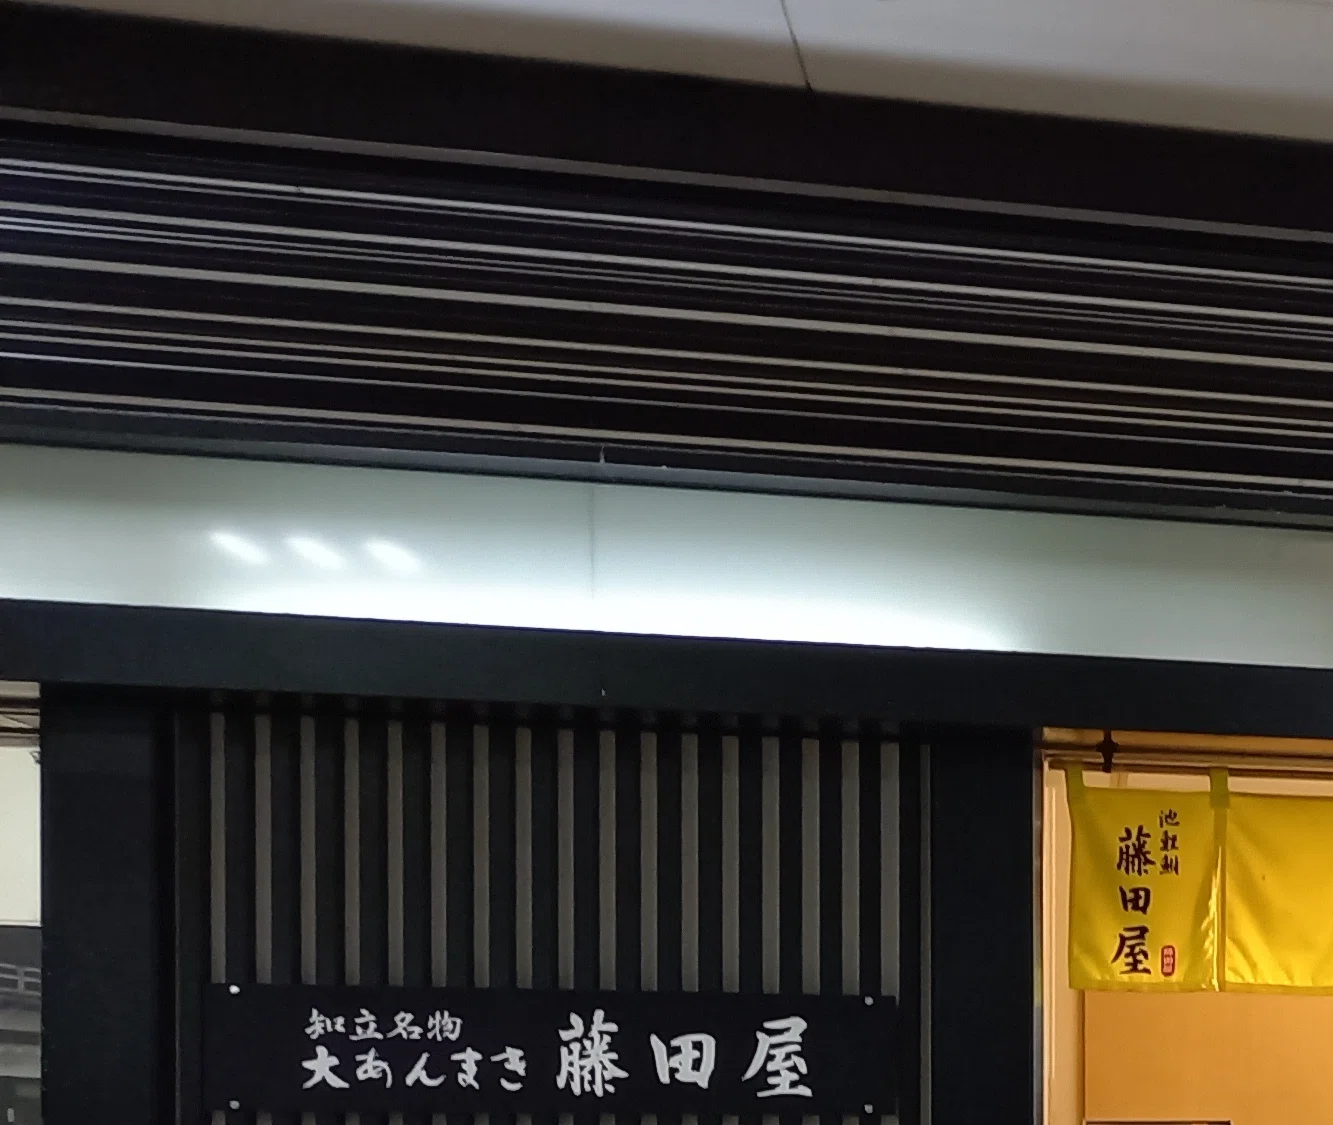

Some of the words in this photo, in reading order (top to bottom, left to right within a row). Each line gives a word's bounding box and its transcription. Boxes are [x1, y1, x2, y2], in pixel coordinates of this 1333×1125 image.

[1111, 824, 1156, 976] 藤田屋
[304, 1007, 462, 1041] 知立名物
[556, 1008, 813, 1099] 藤田屋
[301, 1044, 528, 1093] 大あんまき
